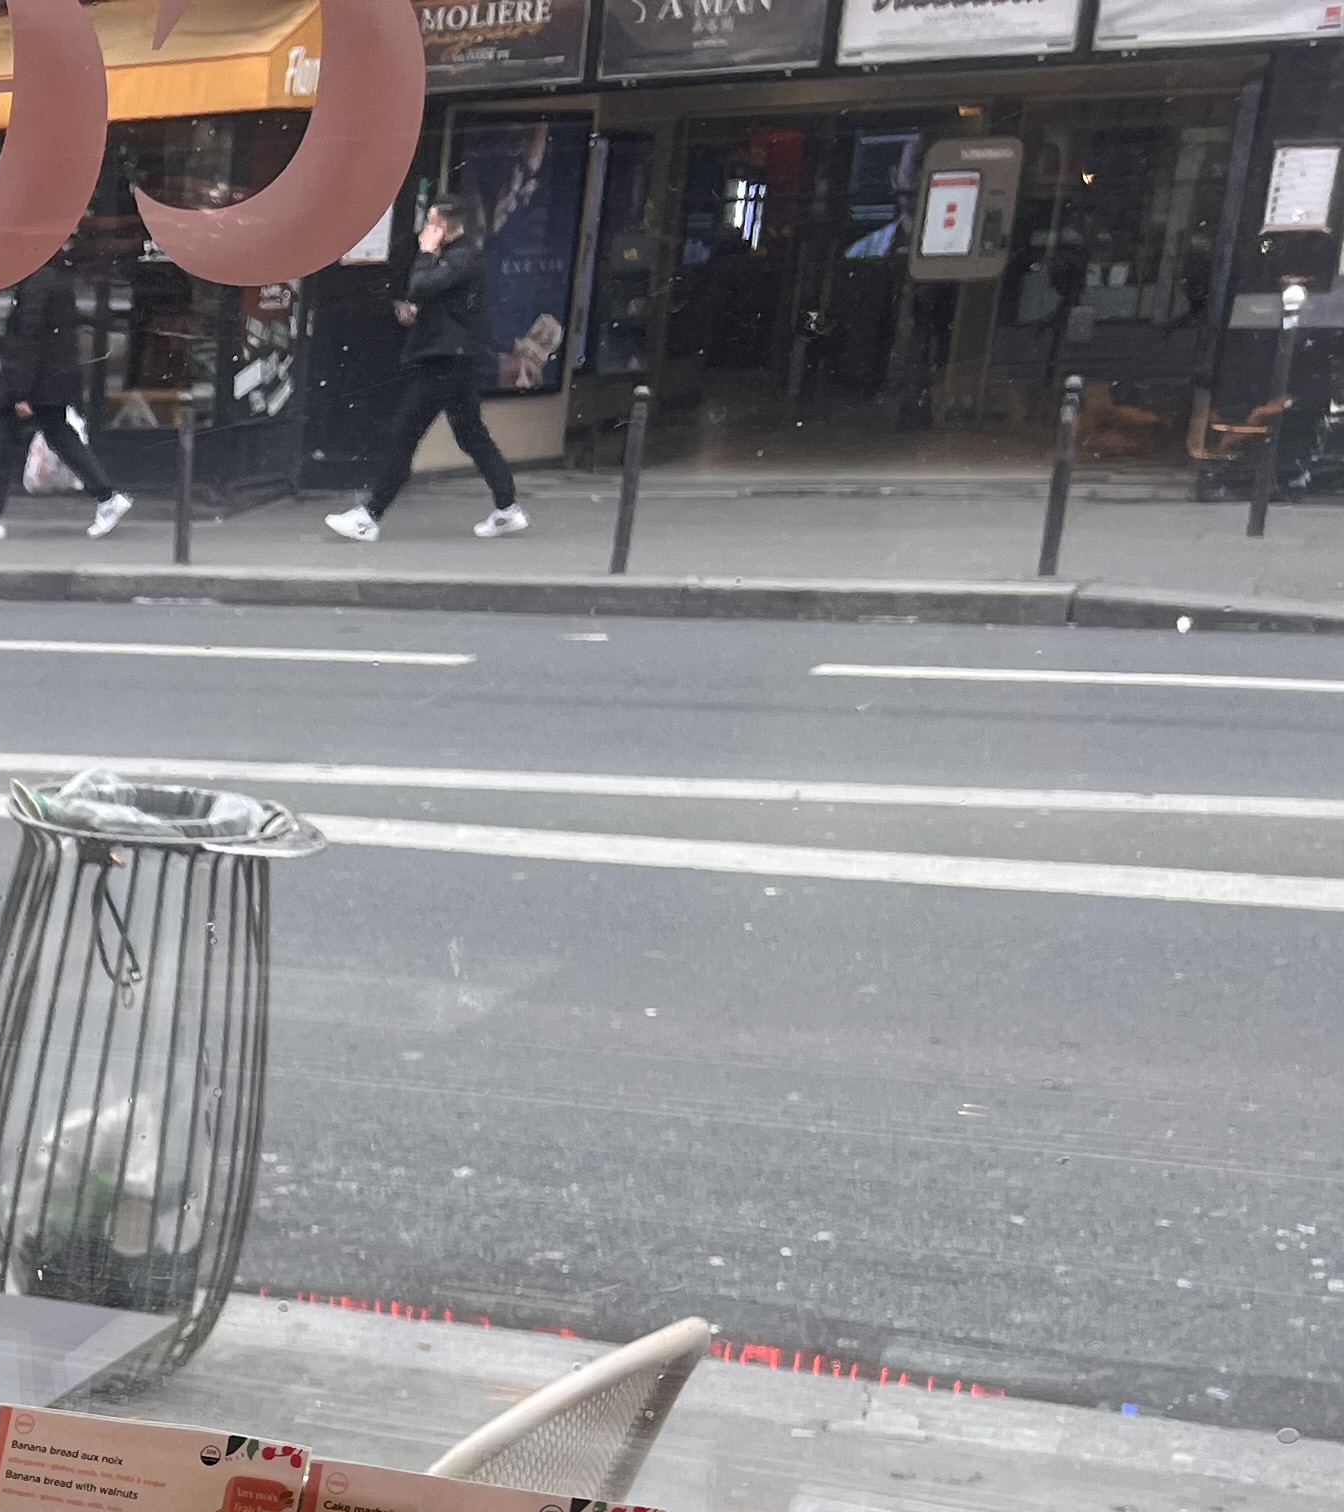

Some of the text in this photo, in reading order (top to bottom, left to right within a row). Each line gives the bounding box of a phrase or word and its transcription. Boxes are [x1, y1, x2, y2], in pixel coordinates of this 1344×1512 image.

[11, 1440, 123, 1466] Banana bread aux noix
[5, 1469, 41, 1483] Banana
[43, 1475, 73, 1488] bread
[75, 1482, 97, 1493] with
[99, 1486, 138, 1500] walnuts
[324, 1500, 351, 1512] Cake
